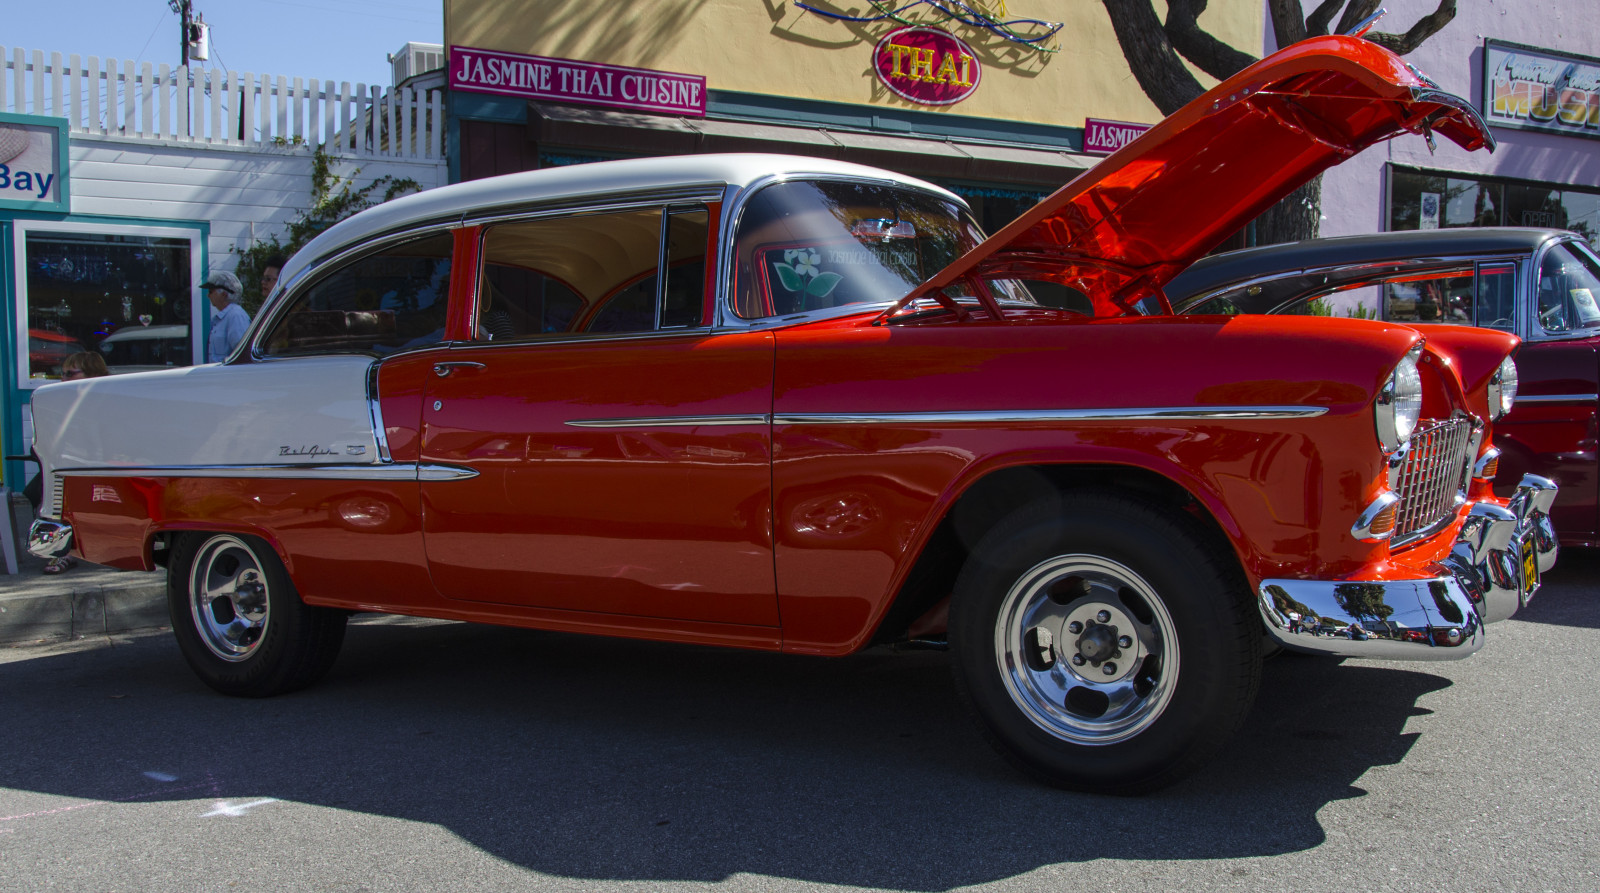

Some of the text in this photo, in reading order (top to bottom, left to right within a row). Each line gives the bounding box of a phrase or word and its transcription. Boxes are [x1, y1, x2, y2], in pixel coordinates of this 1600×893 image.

[456, 54, 701, 107] JASMINE THAI CUISINE
[884, 43, 974, 88] THAI
[1491, 77, 1600, 130] MUSI
[1087, 124, 1146, 148] JASMI
[0, 163, 55, 199] Bay
[889, 248, 918, 266] cuisin
